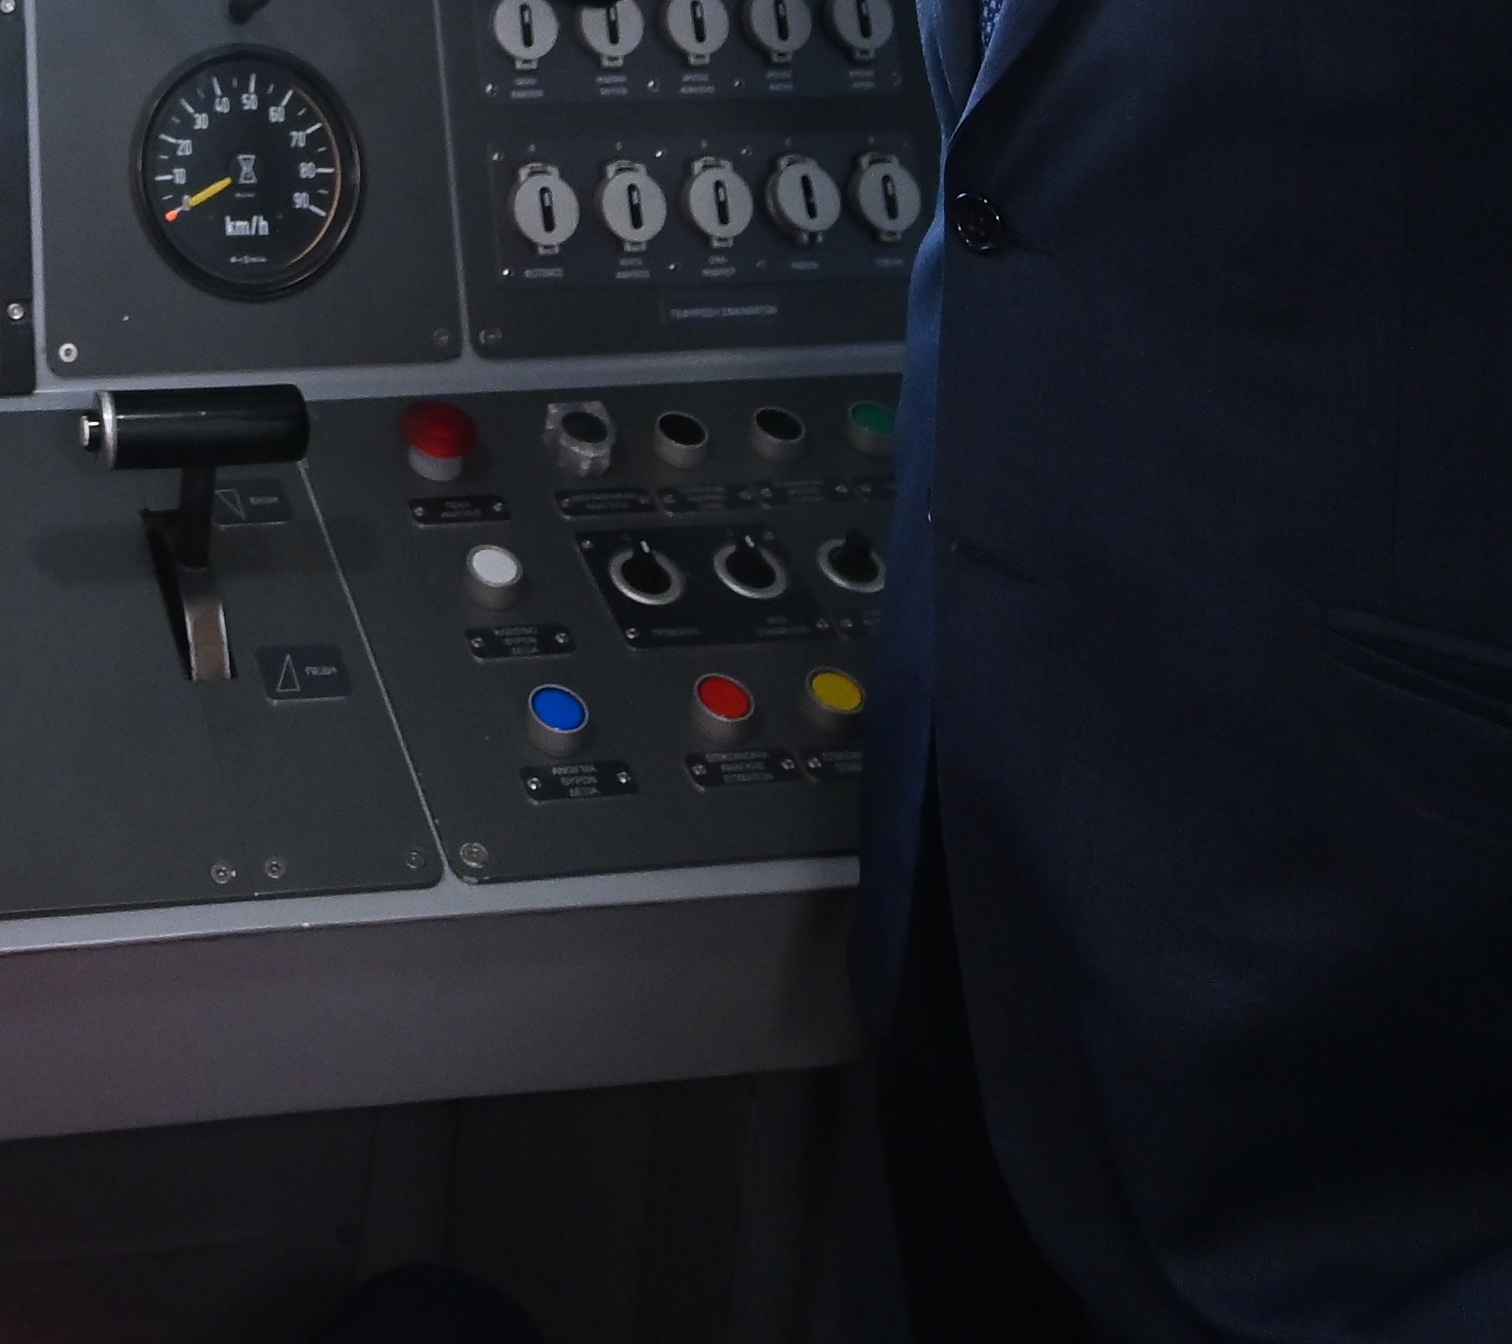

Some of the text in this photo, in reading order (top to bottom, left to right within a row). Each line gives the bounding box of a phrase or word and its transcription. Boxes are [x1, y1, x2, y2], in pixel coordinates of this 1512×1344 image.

[213, 96, 231, 114] 40
[240, 92, 258, 111] 50
[192, 112, 210, 130] 30
[268, 105, 286, 124] 60
[175, 138, 193, 156] 20
[288, 130, 307, 148] 70
[172, 167, 188, 185] 10
[298, 160, 317, 179] 80
[292, 191, 311, 210] 90
[224, 214, 270, 237] km/h
